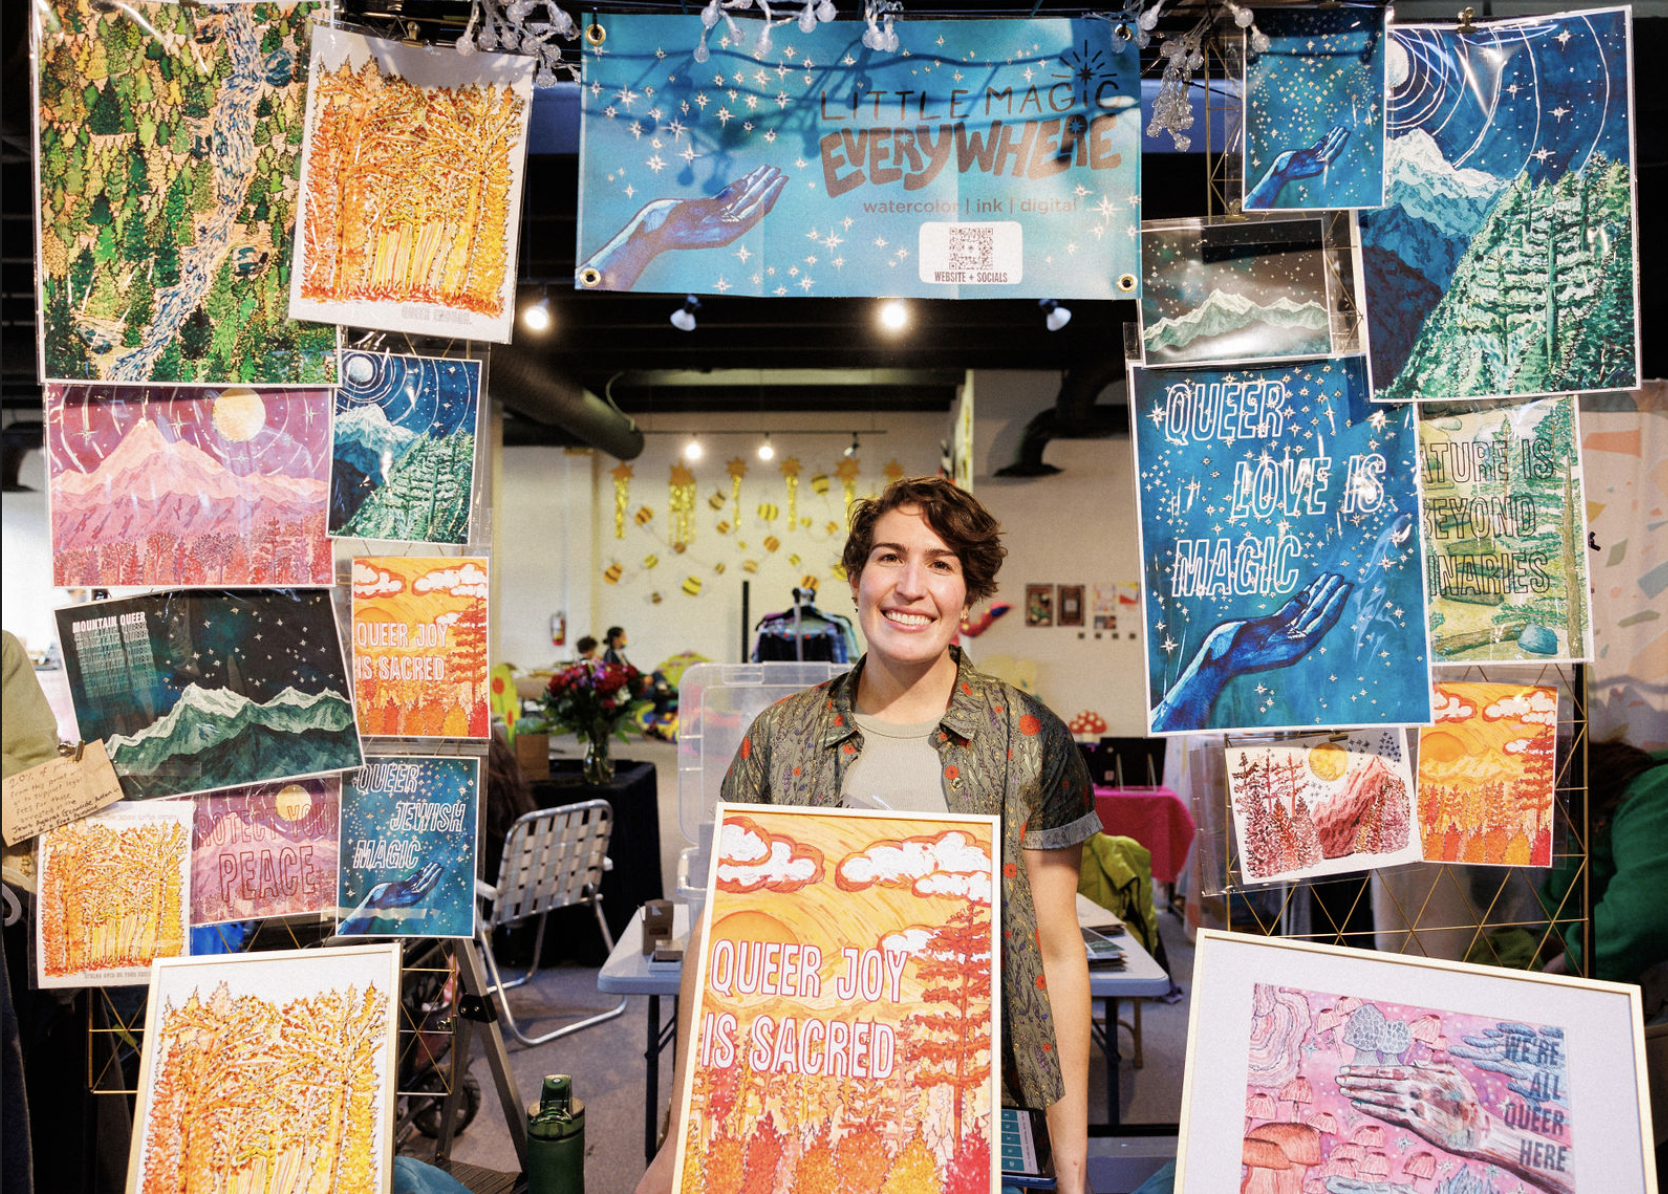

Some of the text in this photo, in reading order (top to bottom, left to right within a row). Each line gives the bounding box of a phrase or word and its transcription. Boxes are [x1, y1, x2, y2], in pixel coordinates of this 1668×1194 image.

[820, 80, 1124, 121] LITTLE MAGIC
[819, 113, 1122, 198] EVERYWHERE
[863, 198, 958, 214] watercolor
[976, 199, 1003, 213] ink
[1020, 198, 1077, 215] digital
[934, 271, 966, 283] WEBSITE
[976, 272, 1009, 284] SOCIALS
[1165, 381, 1287, 446] QUEER
[1420, 437, 1555, 484] ATURE IS
[1230, 453, 1387, 519] LOVE IS
[1172, 535, 1303, 598] MAGIC
[1427, 550, 1551, 597] INARIES
[72, 611, 146, 634] MOUNTAIN QUEER
[356, 621, 450, 648] QUEER JOY
[356, 655, 446, 681] IS SACRED
[356, 763, 420, 795] QUEER
[390, 801, 467, 832] JEWISH
[352, 839, 421, 870] MAGIC
[219, 845, 316, 902] PEACE
[710, 938, 909, 1003] QUEER JOY
[701, 1012, 896, 1080] IS SACRED
[1504, 1034, 1561, 1067] WE'RE
[1529, 1071, 1562, 1101] ALL
[1504, 1101, 1565, 1136] QUEER
[1519, 1138, 1568, 1173] HERE
